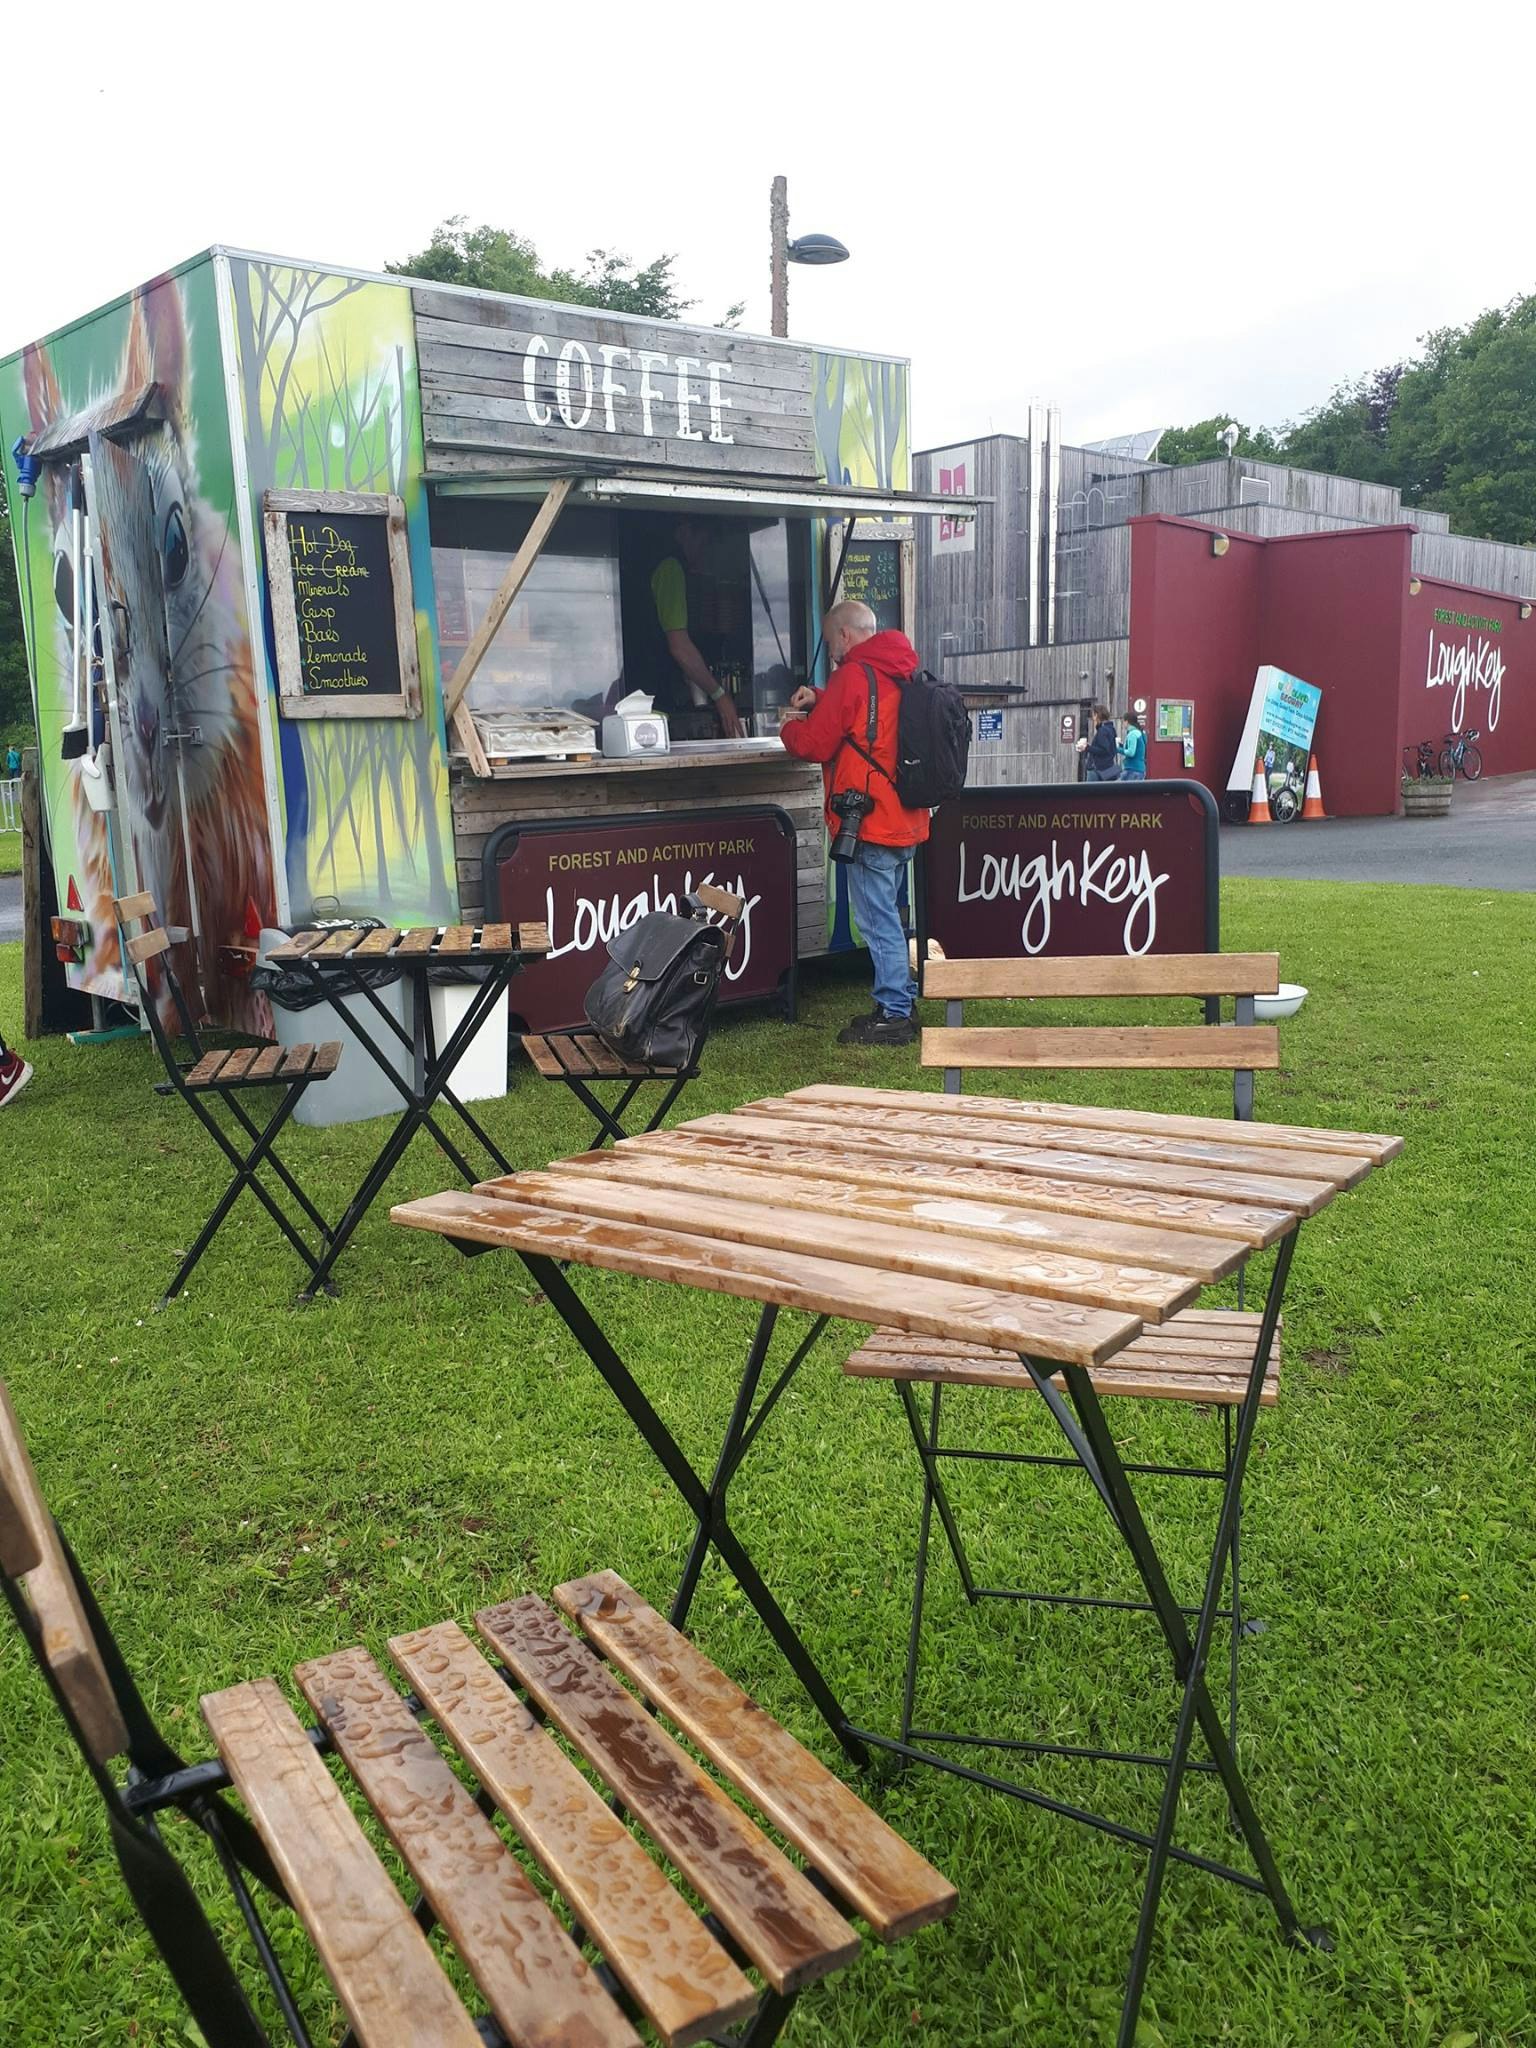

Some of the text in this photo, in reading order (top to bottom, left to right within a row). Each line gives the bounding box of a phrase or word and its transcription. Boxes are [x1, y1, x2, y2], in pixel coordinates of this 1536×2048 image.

[523, 335, 734, 444] COFFEE
[289, 524, 358, 565] Hot Dog
[293, 556, 316, 577] Ice
[1426, 628, 1506, 733] Lough Key
[962, 813, 1163, 829] FOREST AND ACTIVITY PARK
[549, 838, 755, 872] FOREST AND ACTIVITY PARK
[958, 839, 1170, 956] Lough Key
